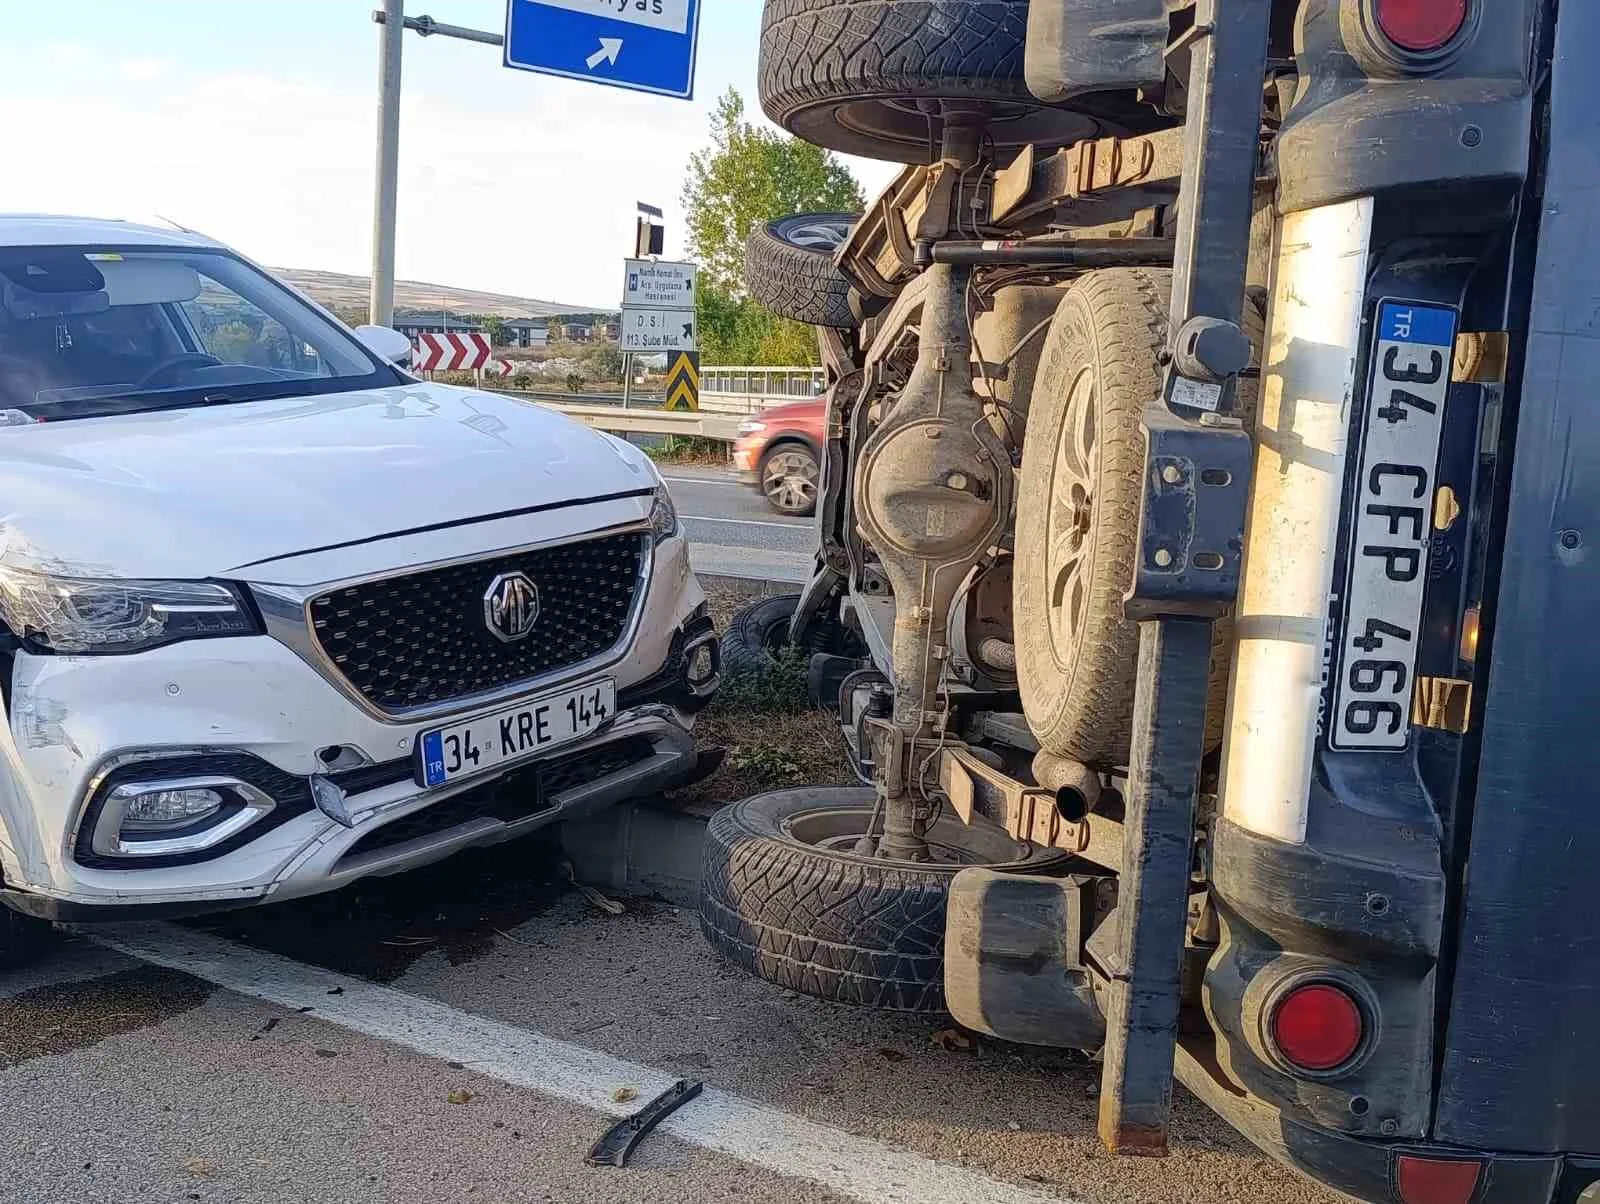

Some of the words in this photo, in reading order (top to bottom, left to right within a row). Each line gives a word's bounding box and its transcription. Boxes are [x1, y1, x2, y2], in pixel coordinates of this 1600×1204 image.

[654, 280, 682, 292] Uygulama
[1393, 310, 1412, 338] TR
[1378, 345, 1443, 424] 34
[1362, 462, 1428, 582] CFP
[493, 578, 536, 633] MG
[1345, 618, 1411, 735] 466
[444, 729, 480, 772] 34
[500, 706, 551, 756] KRE
[567, 687, 606, 732] 144
[428, 761, 443, 774] TR
